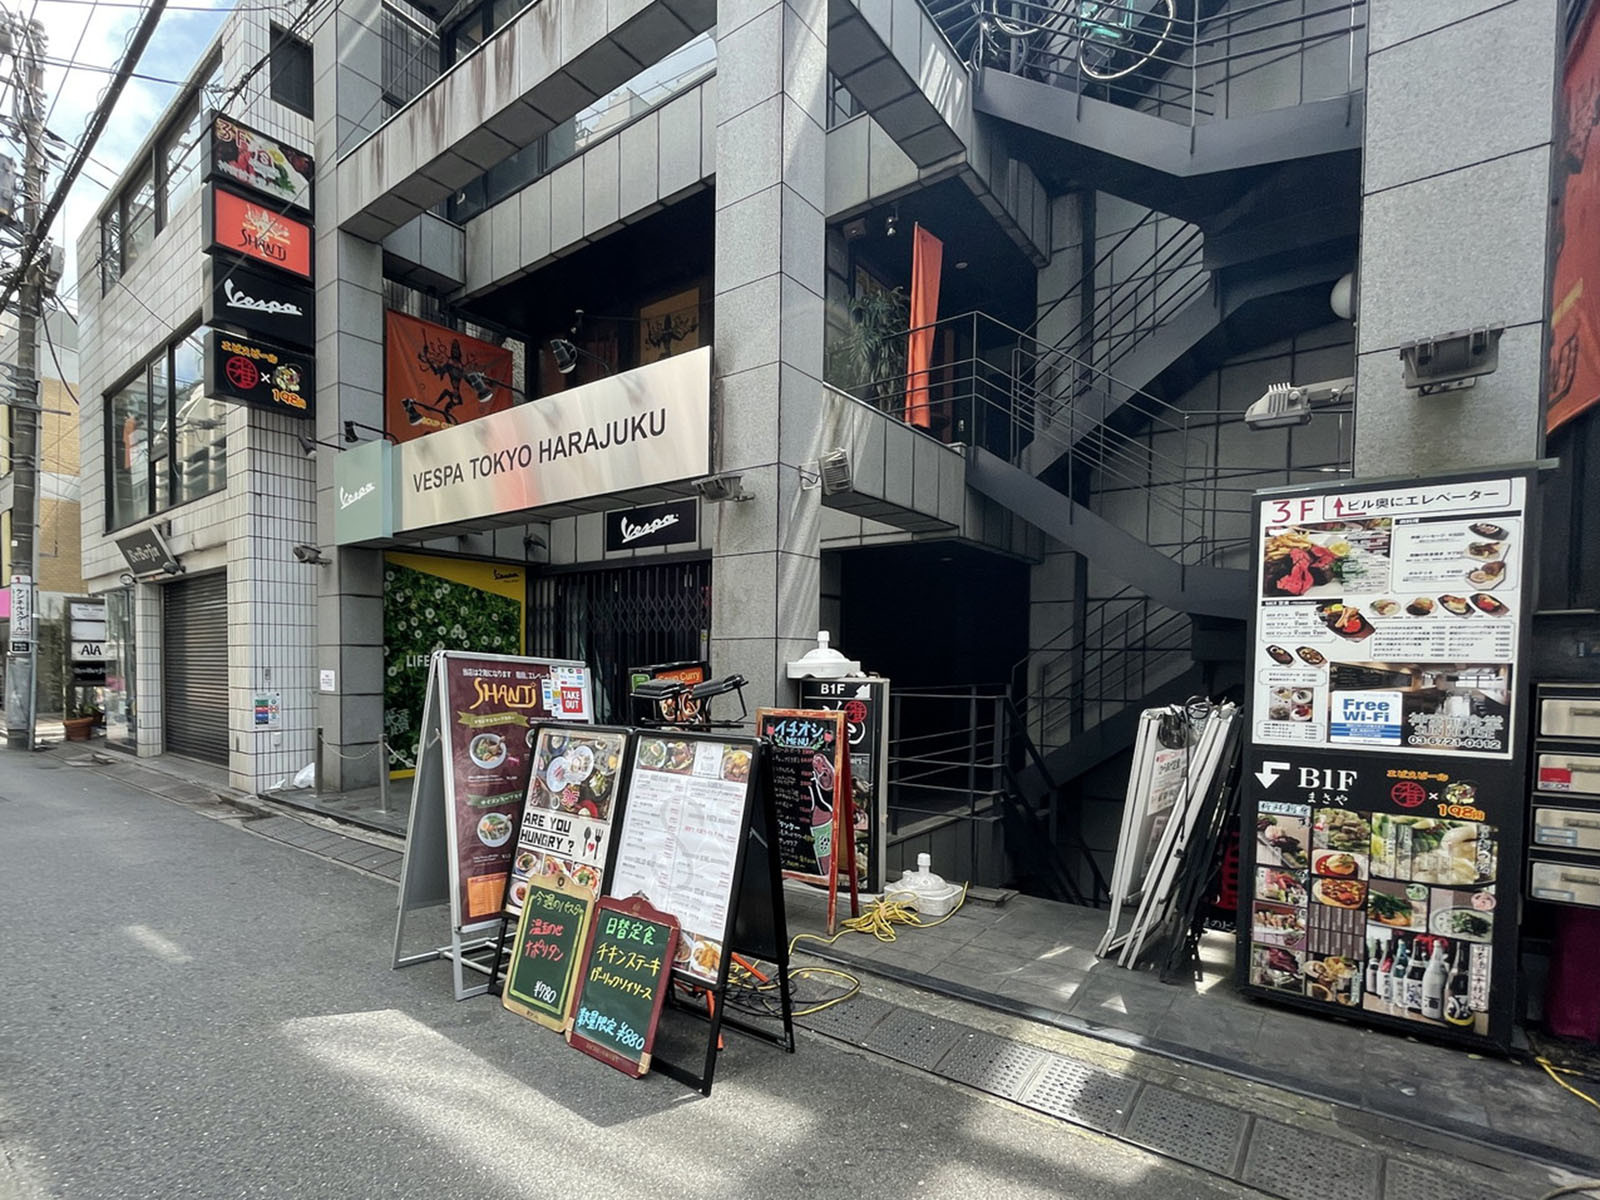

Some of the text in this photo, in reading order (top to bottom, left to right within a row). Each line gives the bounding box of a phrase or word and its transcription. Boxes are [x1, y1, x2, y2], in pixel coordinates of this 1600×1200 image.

[223, 279, 303, 315] Vespa
[413, 408, 666, 493] VESPA TOKYO HARAJUKU
[340, 484, 376, 510] Vespa
[1347, 490, 1500, 512] ビル奥にエレベーター
[1272, 499, 1316, 523] 3F
[620, 515, 679, 543] Vespa
[406, 655, 430, 667] LIFE
[562, 690, 580, 700] TAKE
[821, 683, 846, 695] B1F
[1343, 698, 1390, 711] Free
[1343, 711, 1390, 722] Wi-Fi
[775, 720, 824, 738] イチオシ
[786, 737, 809, 746] MENU
[1298, 767, 1358, 791] B1F
[1307, 792, 1348, 806] まさや
[523, 812, 572, 834] ARE YOU
[520, 829, 563, 849] HUNGRY
[605, 917, 656, 945] 日替定食
[596, 942, 661, 977] チキンステーキ
[533, 980, 557, 1003] ¥780
[615, 1022, 645, 1050] ¥880
